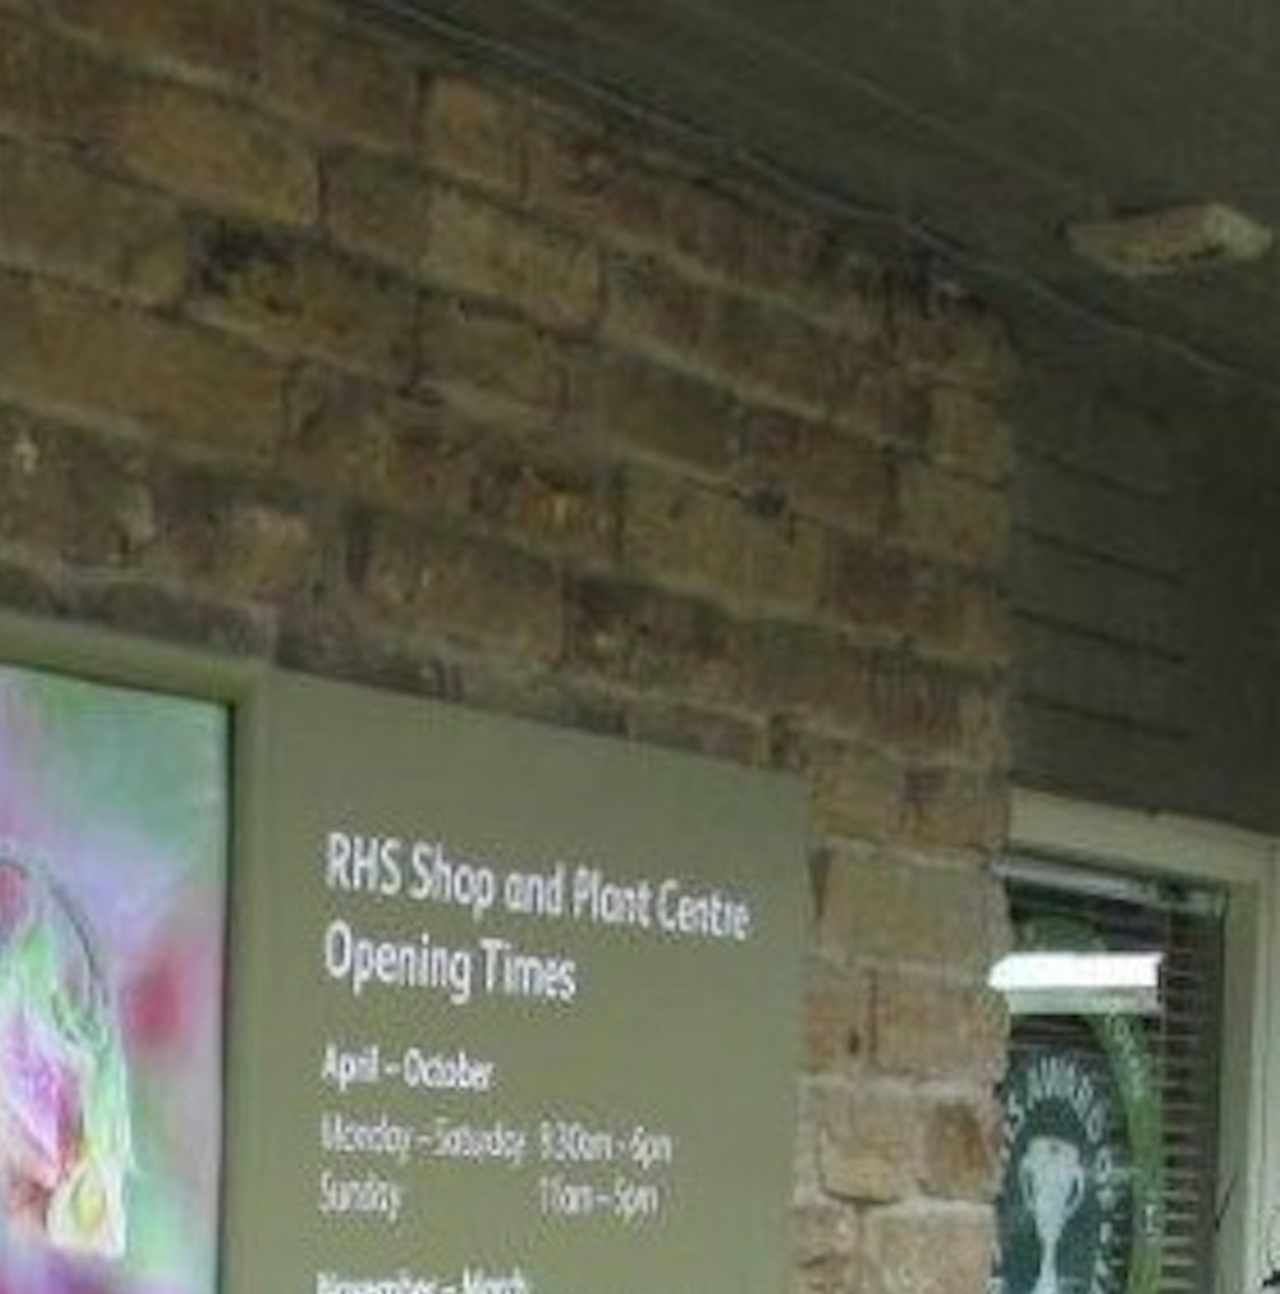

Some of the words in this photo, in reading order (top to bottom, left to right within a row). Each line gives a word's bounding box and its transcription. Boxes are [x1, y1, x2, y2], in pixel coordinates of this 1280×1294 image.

[325, 832, 401, 897] RHS
[411, 841, 494, 922] Shop
[505, 862, 562, 917] and
[573, 865, 650, 929] Plant
[657, 878, 750, 941] Centre
[325, 920, 471, 1003] Opening
[481, 937, 576, 1000] Times
[321, 1043, 378, 1091] April
[403, 1048, 494, 1092] October
[321, 1112, 413, 1163] Monday
[320, 1169, 401, 1222] Sunday
